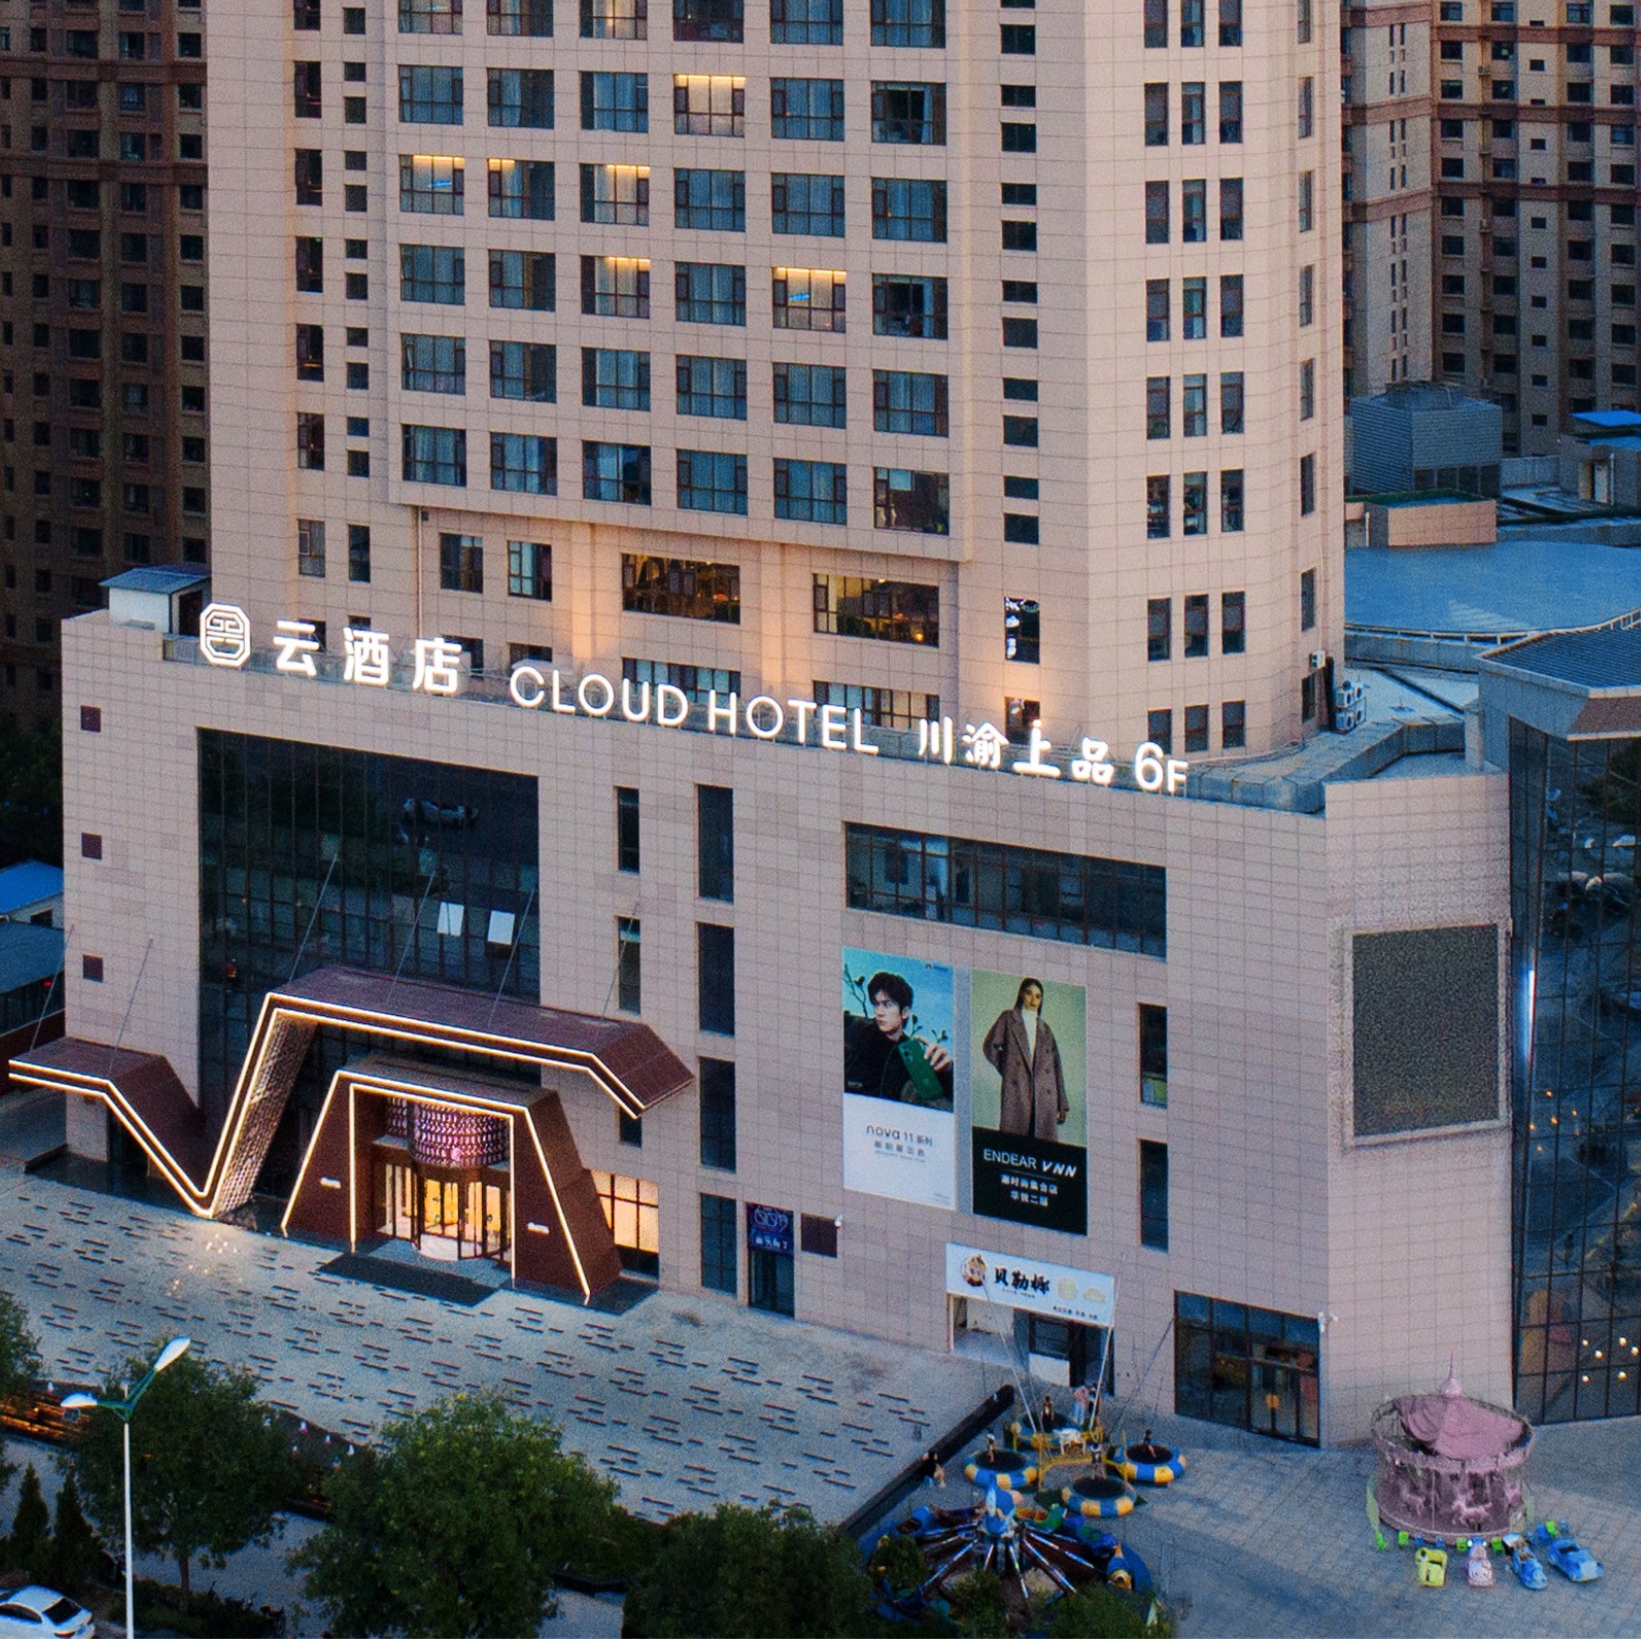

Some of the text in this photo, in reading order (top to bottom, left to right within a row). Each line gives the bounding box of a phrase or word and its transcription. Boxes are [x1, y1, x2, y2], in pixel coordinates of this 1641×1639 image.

[273, 620, 463, 694] 云酒店
[510, 666, 879, 754] CLOUD HOTEL
[919, 716, 1189, 794] 川渝上品 6F
[866, 1124, 900, 1140] nova
[983, 1148, 1037, 1170] ENDEAR
